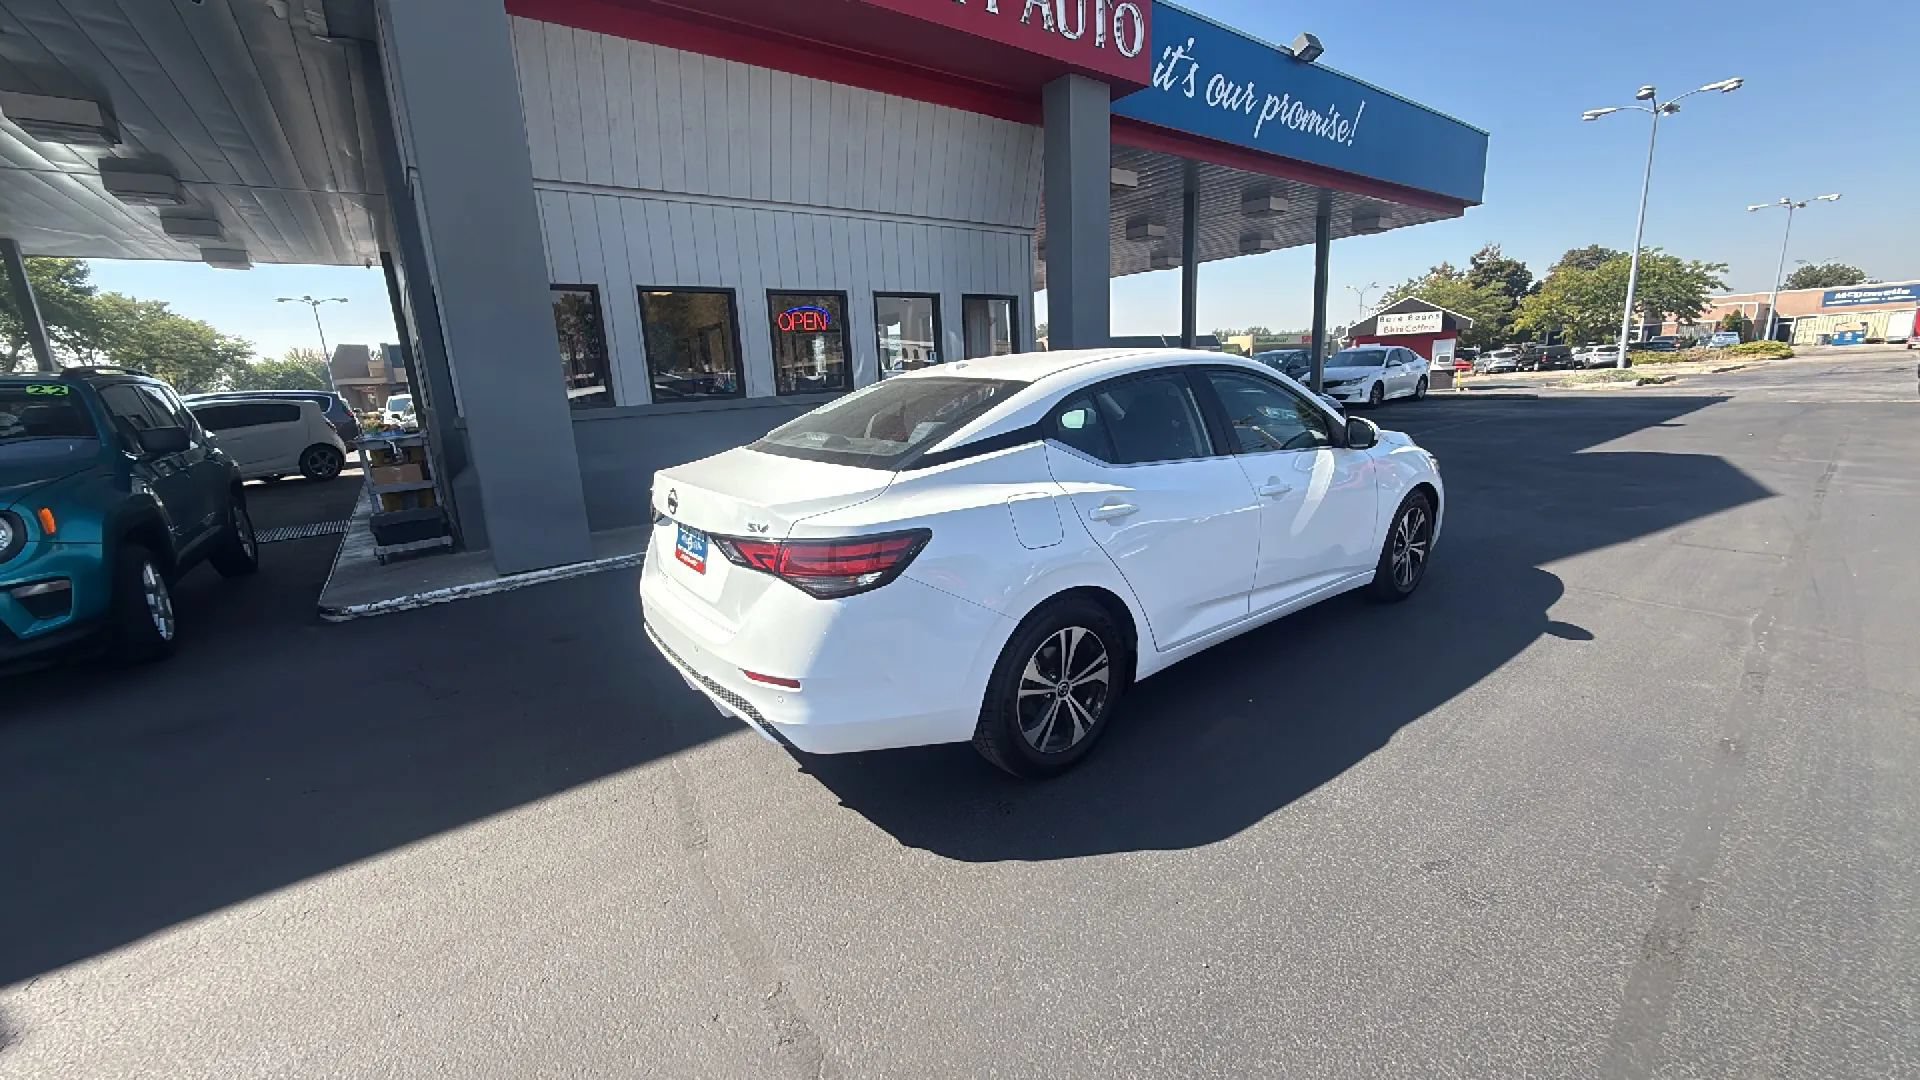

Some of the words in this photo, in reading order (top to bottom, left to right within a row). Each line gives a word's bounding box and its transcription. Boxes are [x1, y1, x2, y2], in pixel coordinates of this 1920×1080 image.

[1152, 37, 1200, 98] it's
[1206, 73, 1258, 115] our
[1253, 100, 1367, 147] promise!
[778, 312, 827, 331] OPEN
[747, 521, 769, 534] SV
